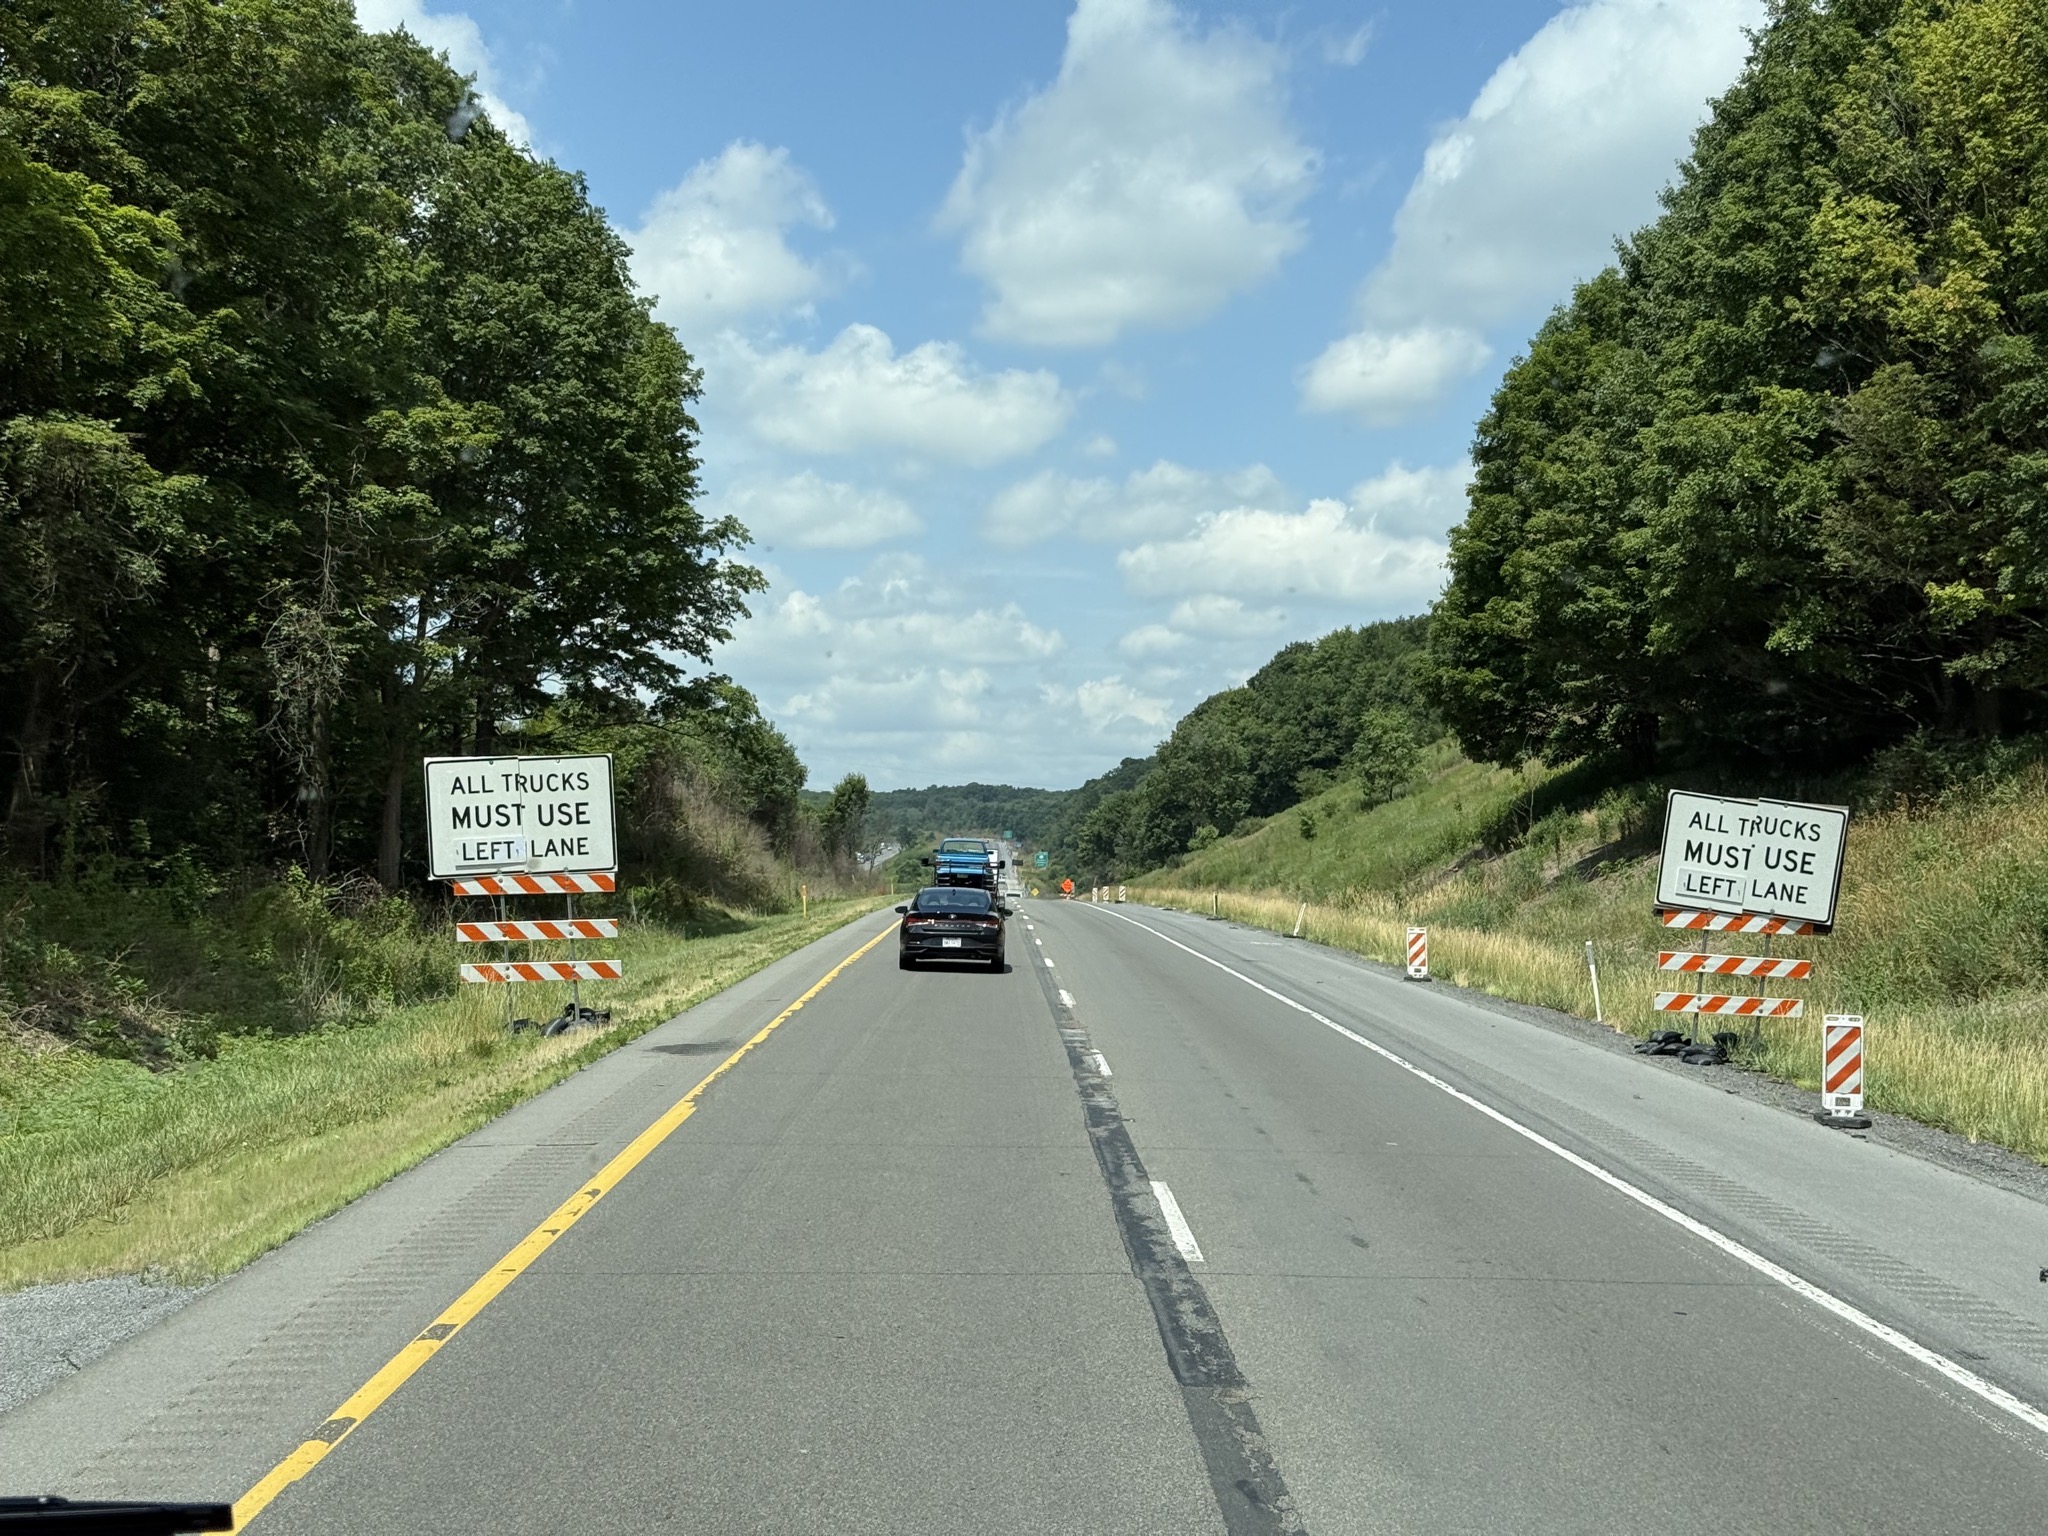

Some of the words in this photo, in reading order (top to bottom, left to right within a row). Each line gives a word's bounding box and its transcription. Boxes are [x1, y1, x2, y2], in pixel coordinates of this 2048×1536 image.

[451, 776, 494, 795] ALL
[501, 772, 590, 793] TRUCKS
[452, 803, 525, 829] MUST
[538, 802, 591, 826] USE
[1688, 811, 1729, 834] ALL
[1738, 815, 1821, 842] TRUCKS
[462, 841, 515, 861] LEFT
[531, 837, 590, 857] LANE
[1684, 839, 1755, 870] MUST
[1764, 846, 1816, 875] USE
[1686, 874, 1737, 897] LEFT
[1752, 879, 1808, 904] LANE
